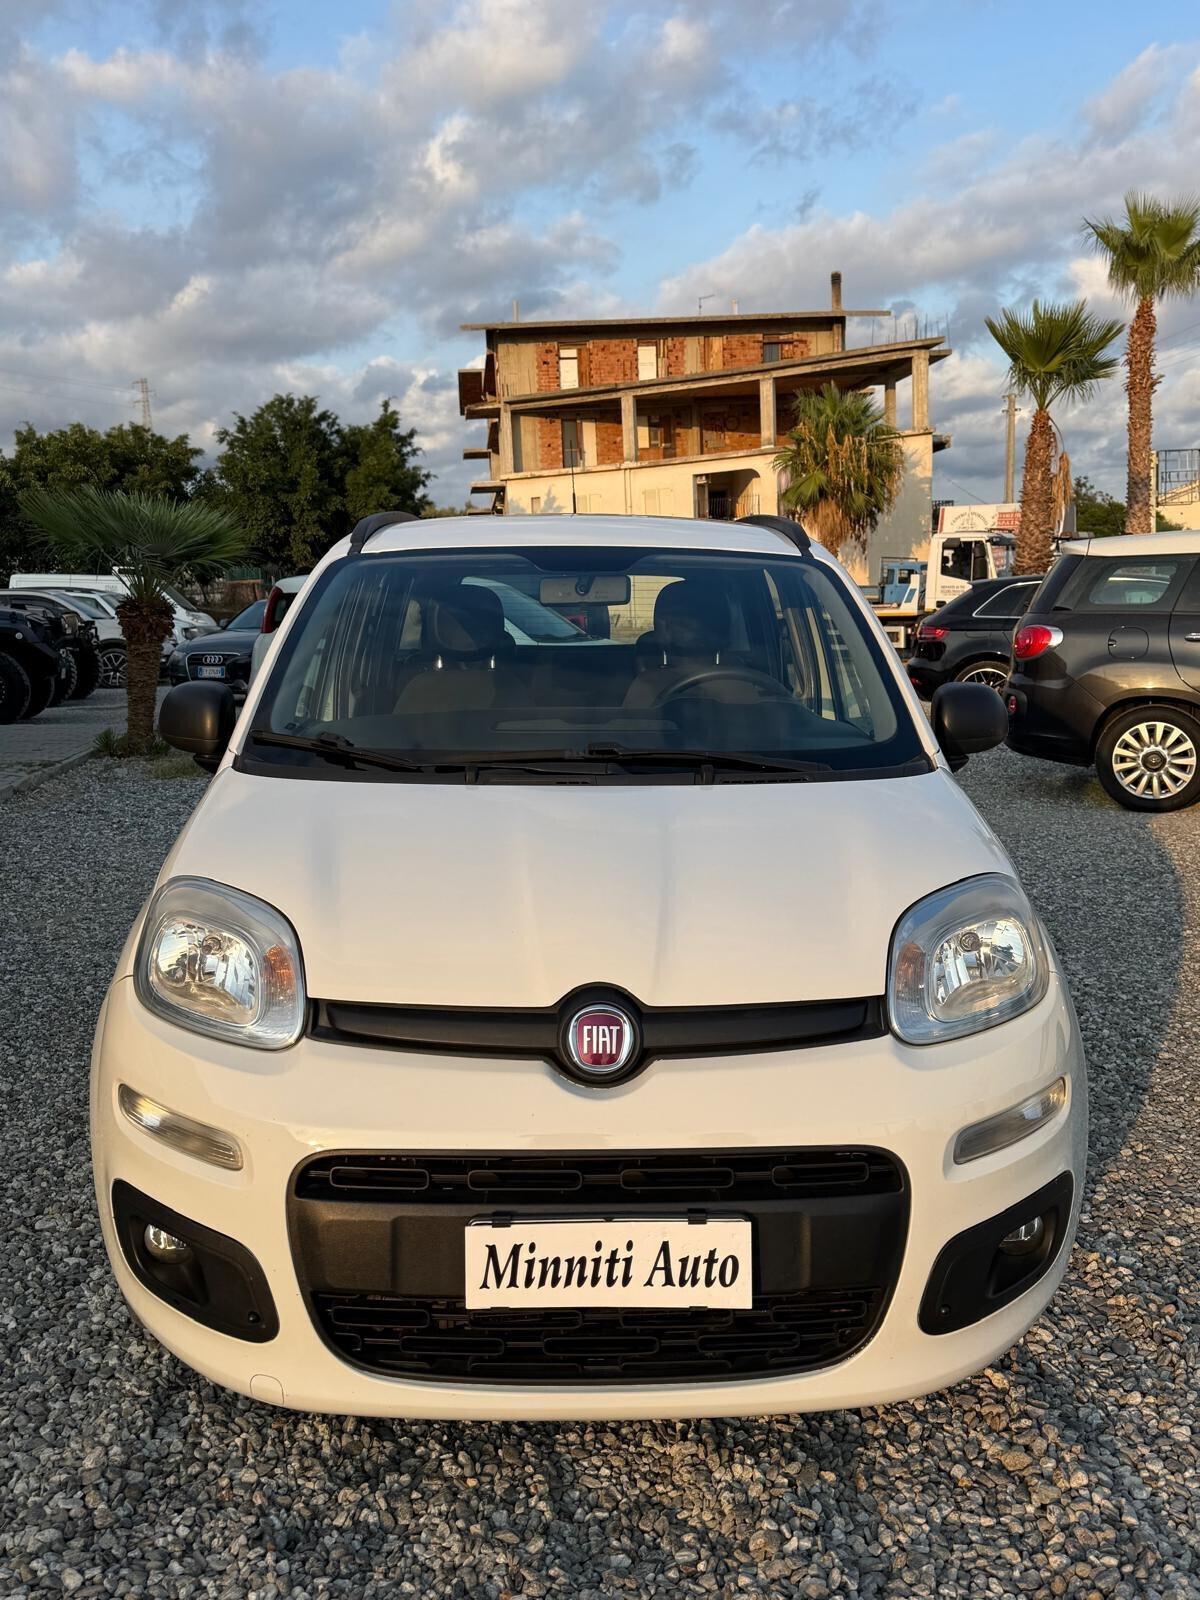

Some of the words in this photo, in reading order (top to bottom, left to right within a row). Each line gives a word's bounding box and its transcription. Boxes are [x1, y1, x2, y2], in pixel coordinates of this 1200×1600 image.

[583, 1025, 620, 1054] FIAT
[479, 1239, 634, 1289] Minniti
[643, 1240, 740, 1288] Auto
